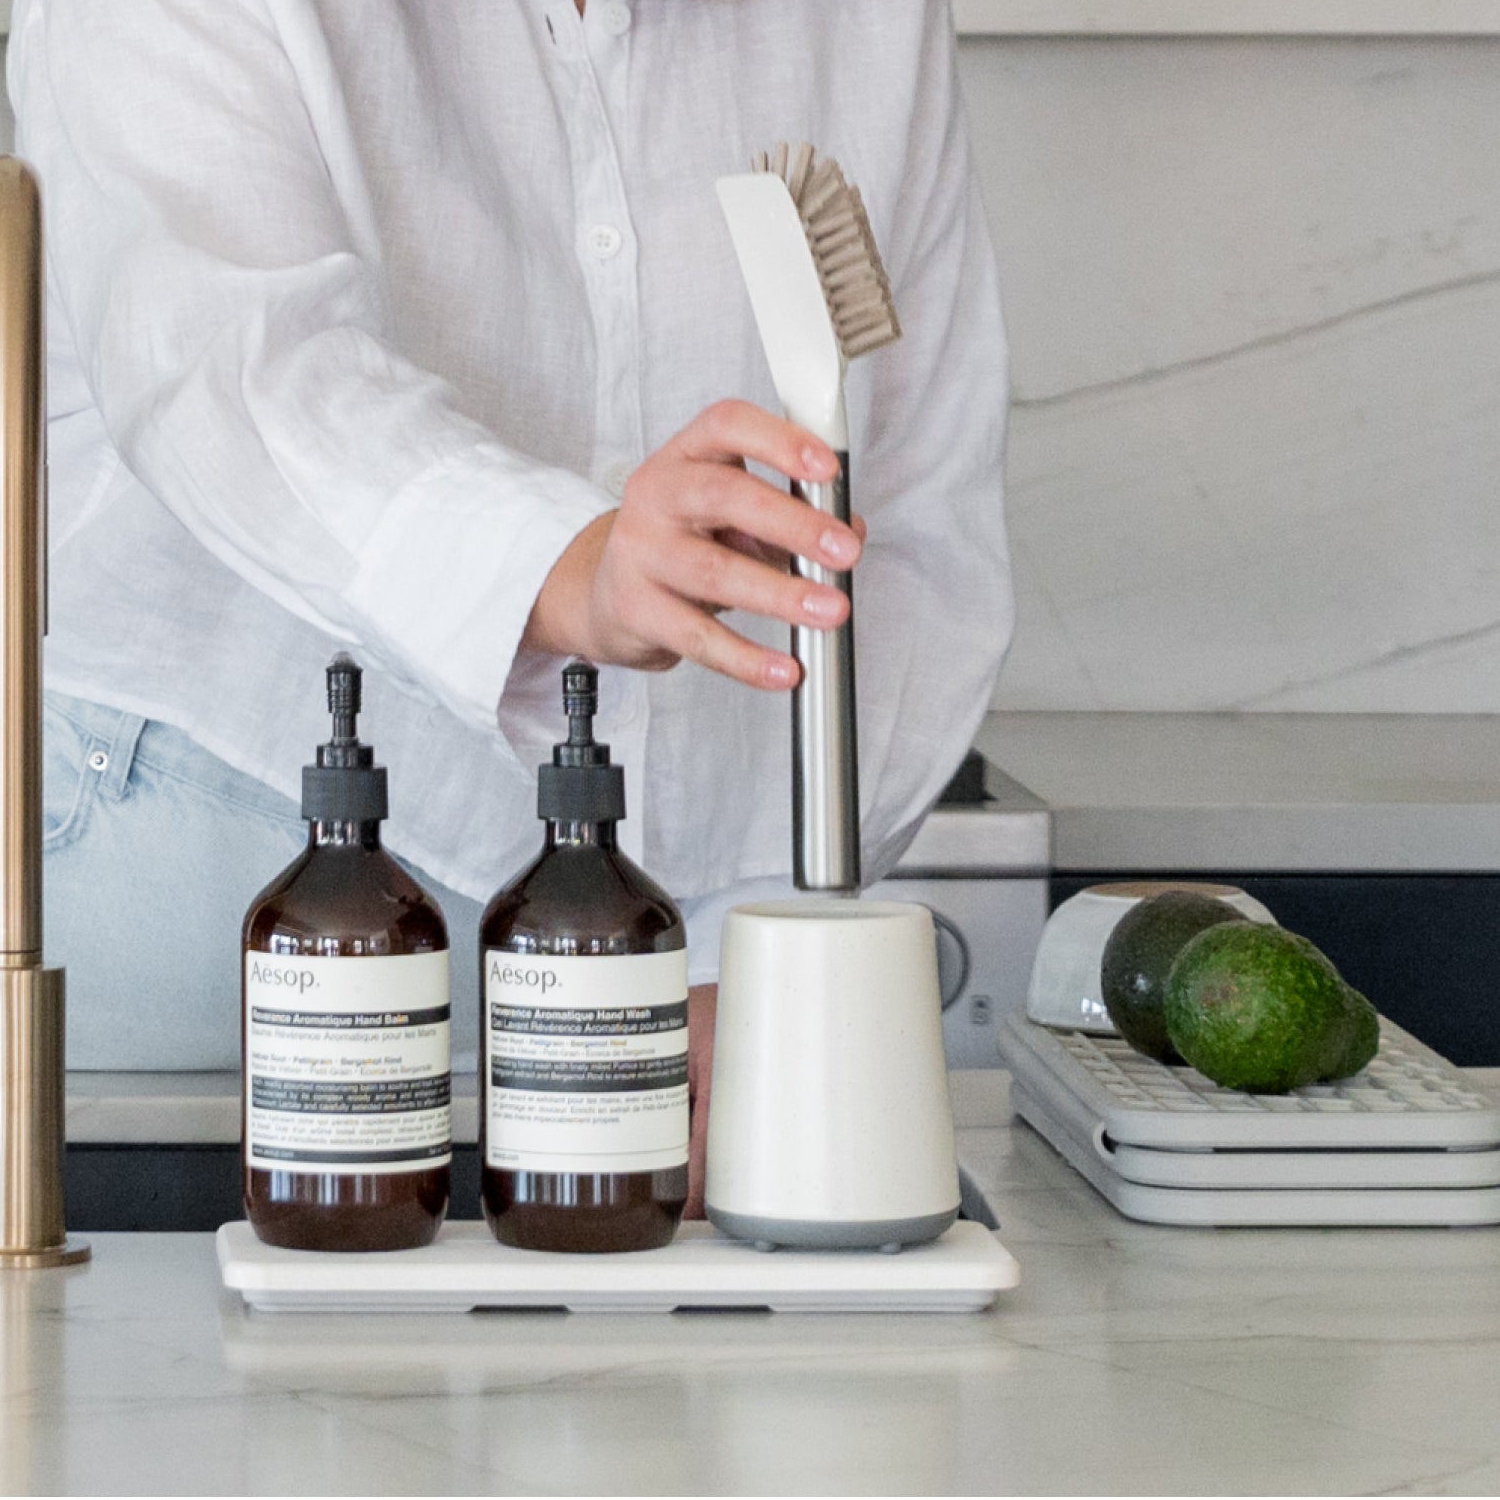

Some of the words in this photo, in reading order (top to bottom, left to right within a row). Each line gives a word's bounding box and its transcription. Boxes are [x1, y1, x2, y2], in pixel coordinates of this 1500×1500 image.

[293, 1012, 353, 1027] Aromatique
[355, 1014, 382, 1025] Hand
[534, 1008, 595, 1022] Aromatique
[597, 1009, 624, 1020] Hand
[626, 1008, 652, 1019] Wash
[585, 1021, 638, 1034] Aromatique
[640, 1021, 658, 1033] pour
[323, 1030, 380, 1044] Aromatique
